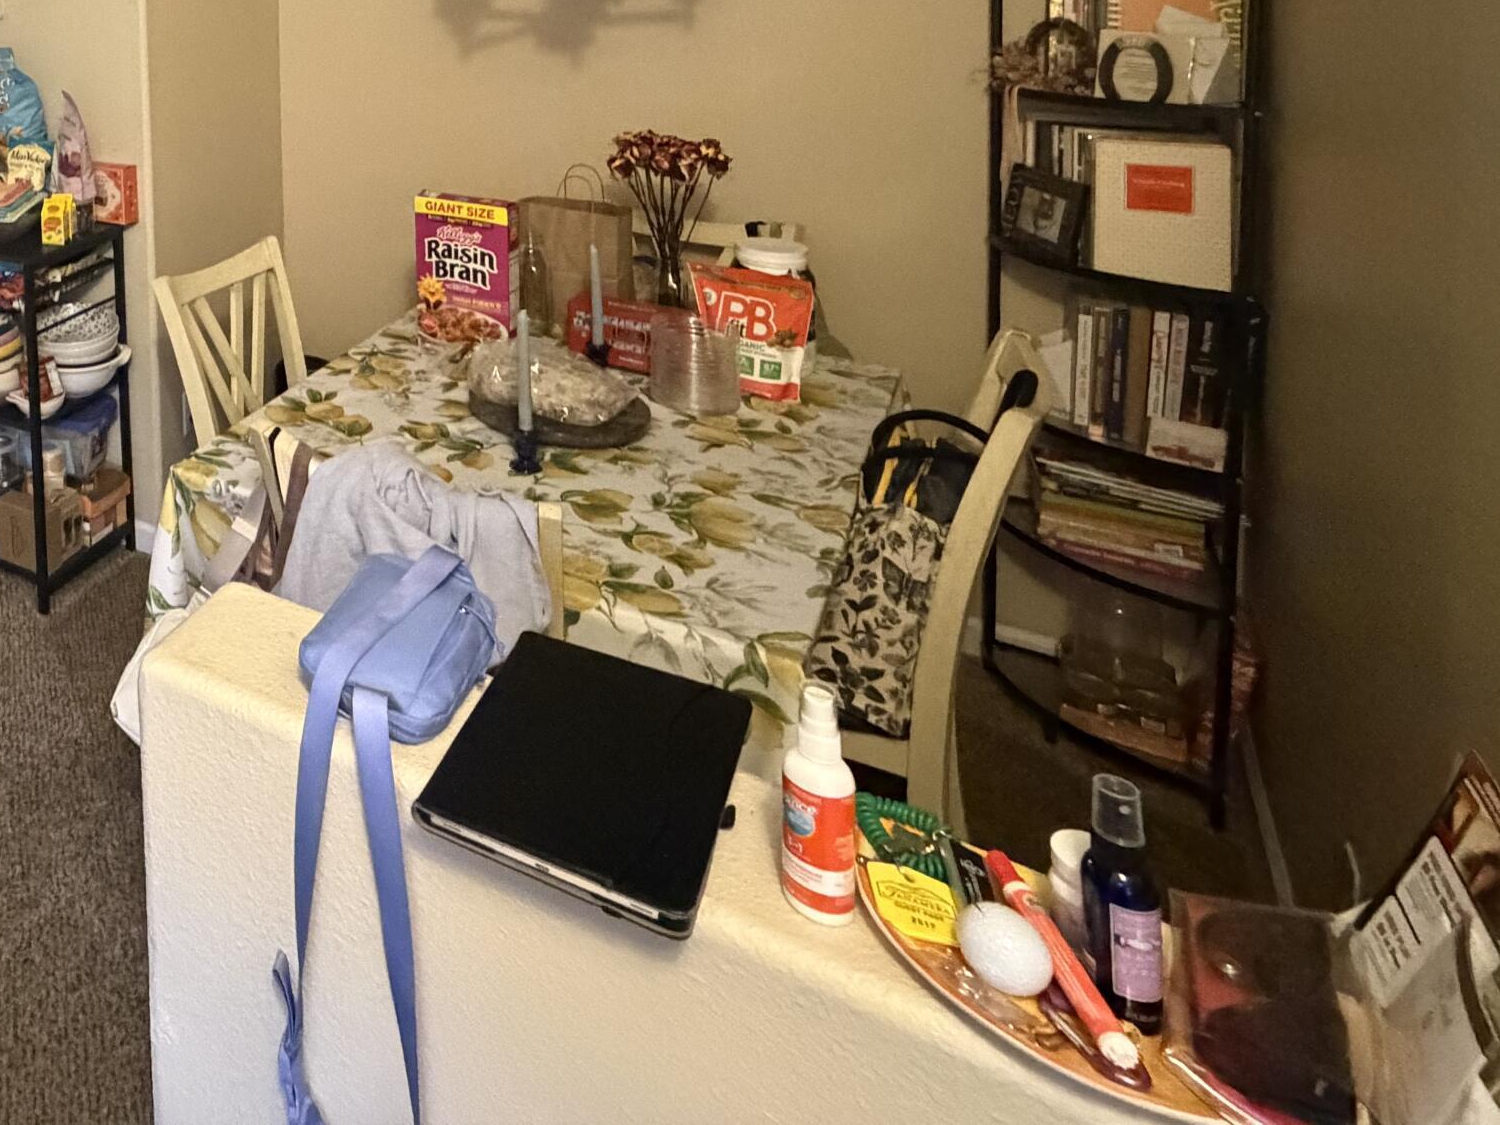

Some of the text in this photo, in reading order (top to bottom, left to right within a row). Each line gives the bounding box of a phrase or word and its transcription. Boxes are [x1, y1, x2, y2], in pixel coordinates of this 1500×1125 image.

[425, 201, 495, 220] GIANT SIZE
[436, 224, 482, 245] Kellogg's
[426, 239, 495, 272] Raisin
[434, 260, 488, 288] Bran
[717, 291, 777, 341] PB
